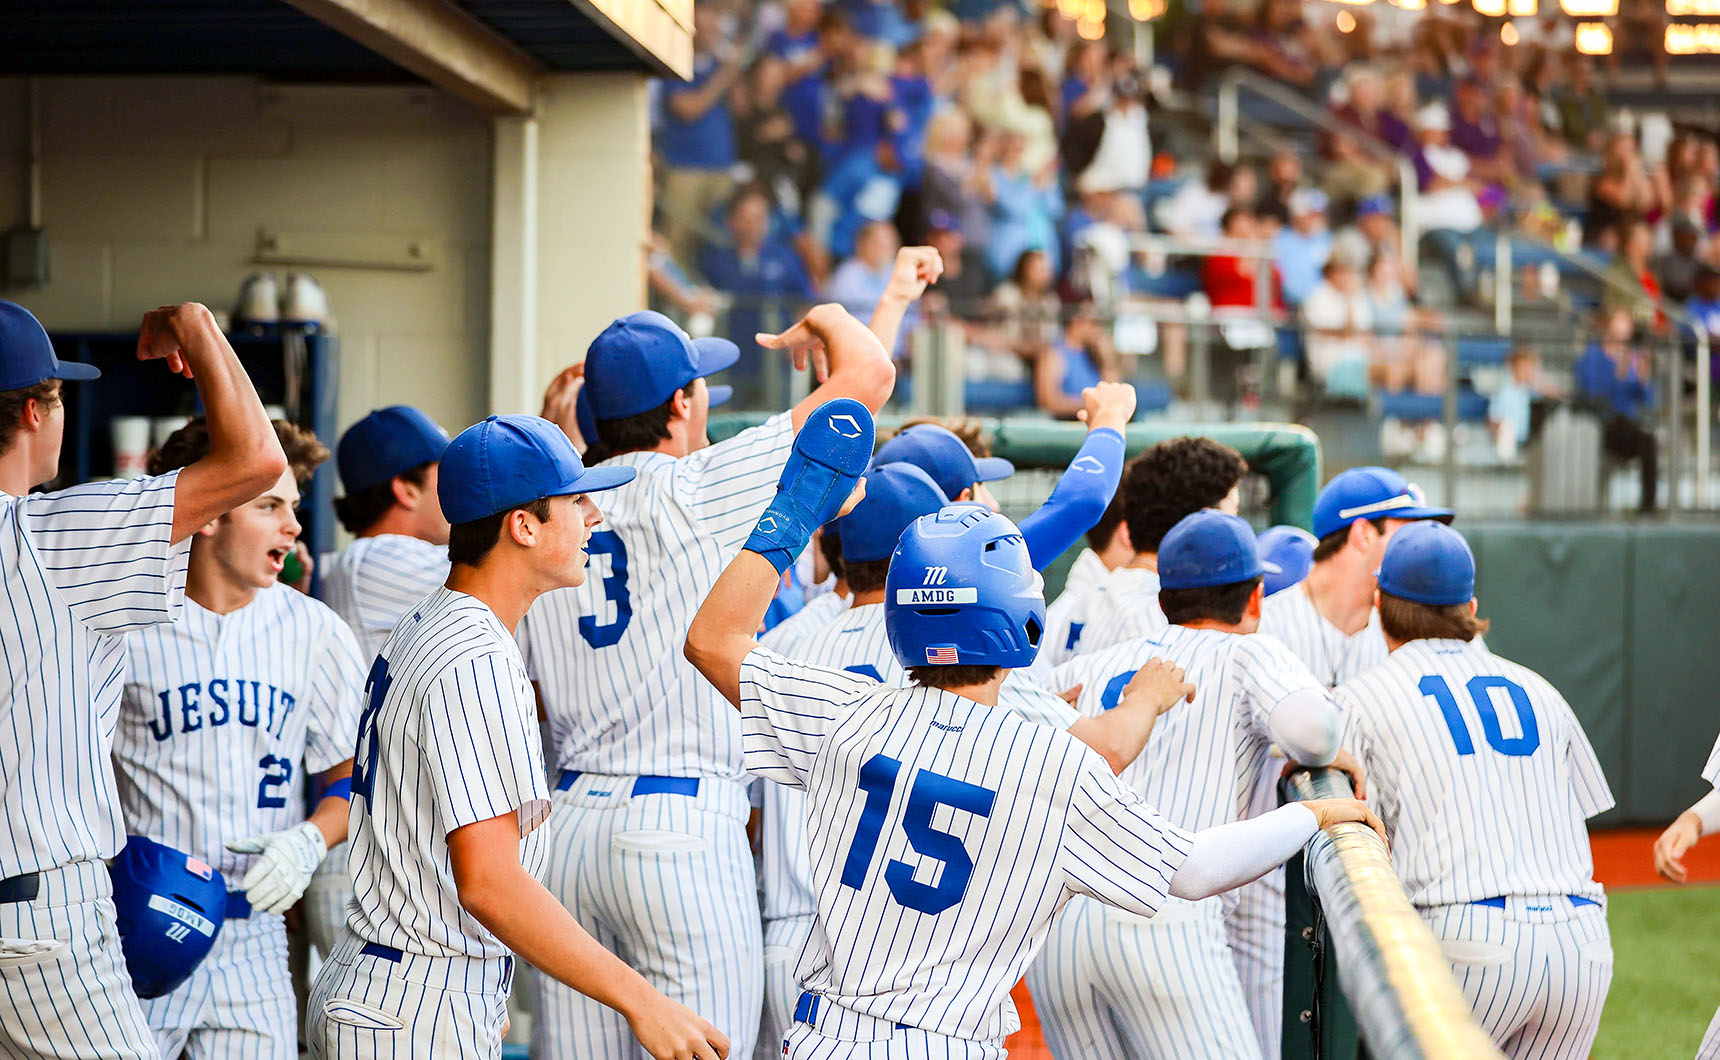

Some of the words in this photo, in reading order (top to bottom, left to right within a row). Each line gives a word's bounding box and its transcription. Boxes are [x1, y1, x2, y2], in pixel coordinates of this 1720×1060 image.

[578, 530, 633, 650] 3
[911, 590, 955, 602] AMDG
[149, 679, 296, 742] JESUIT
[929, 720, 965, 733] marucci
[1418, 675, 1540, 756] 10
[257, 753, 293, 808] 2
[840, 753, 996, 916] 15
